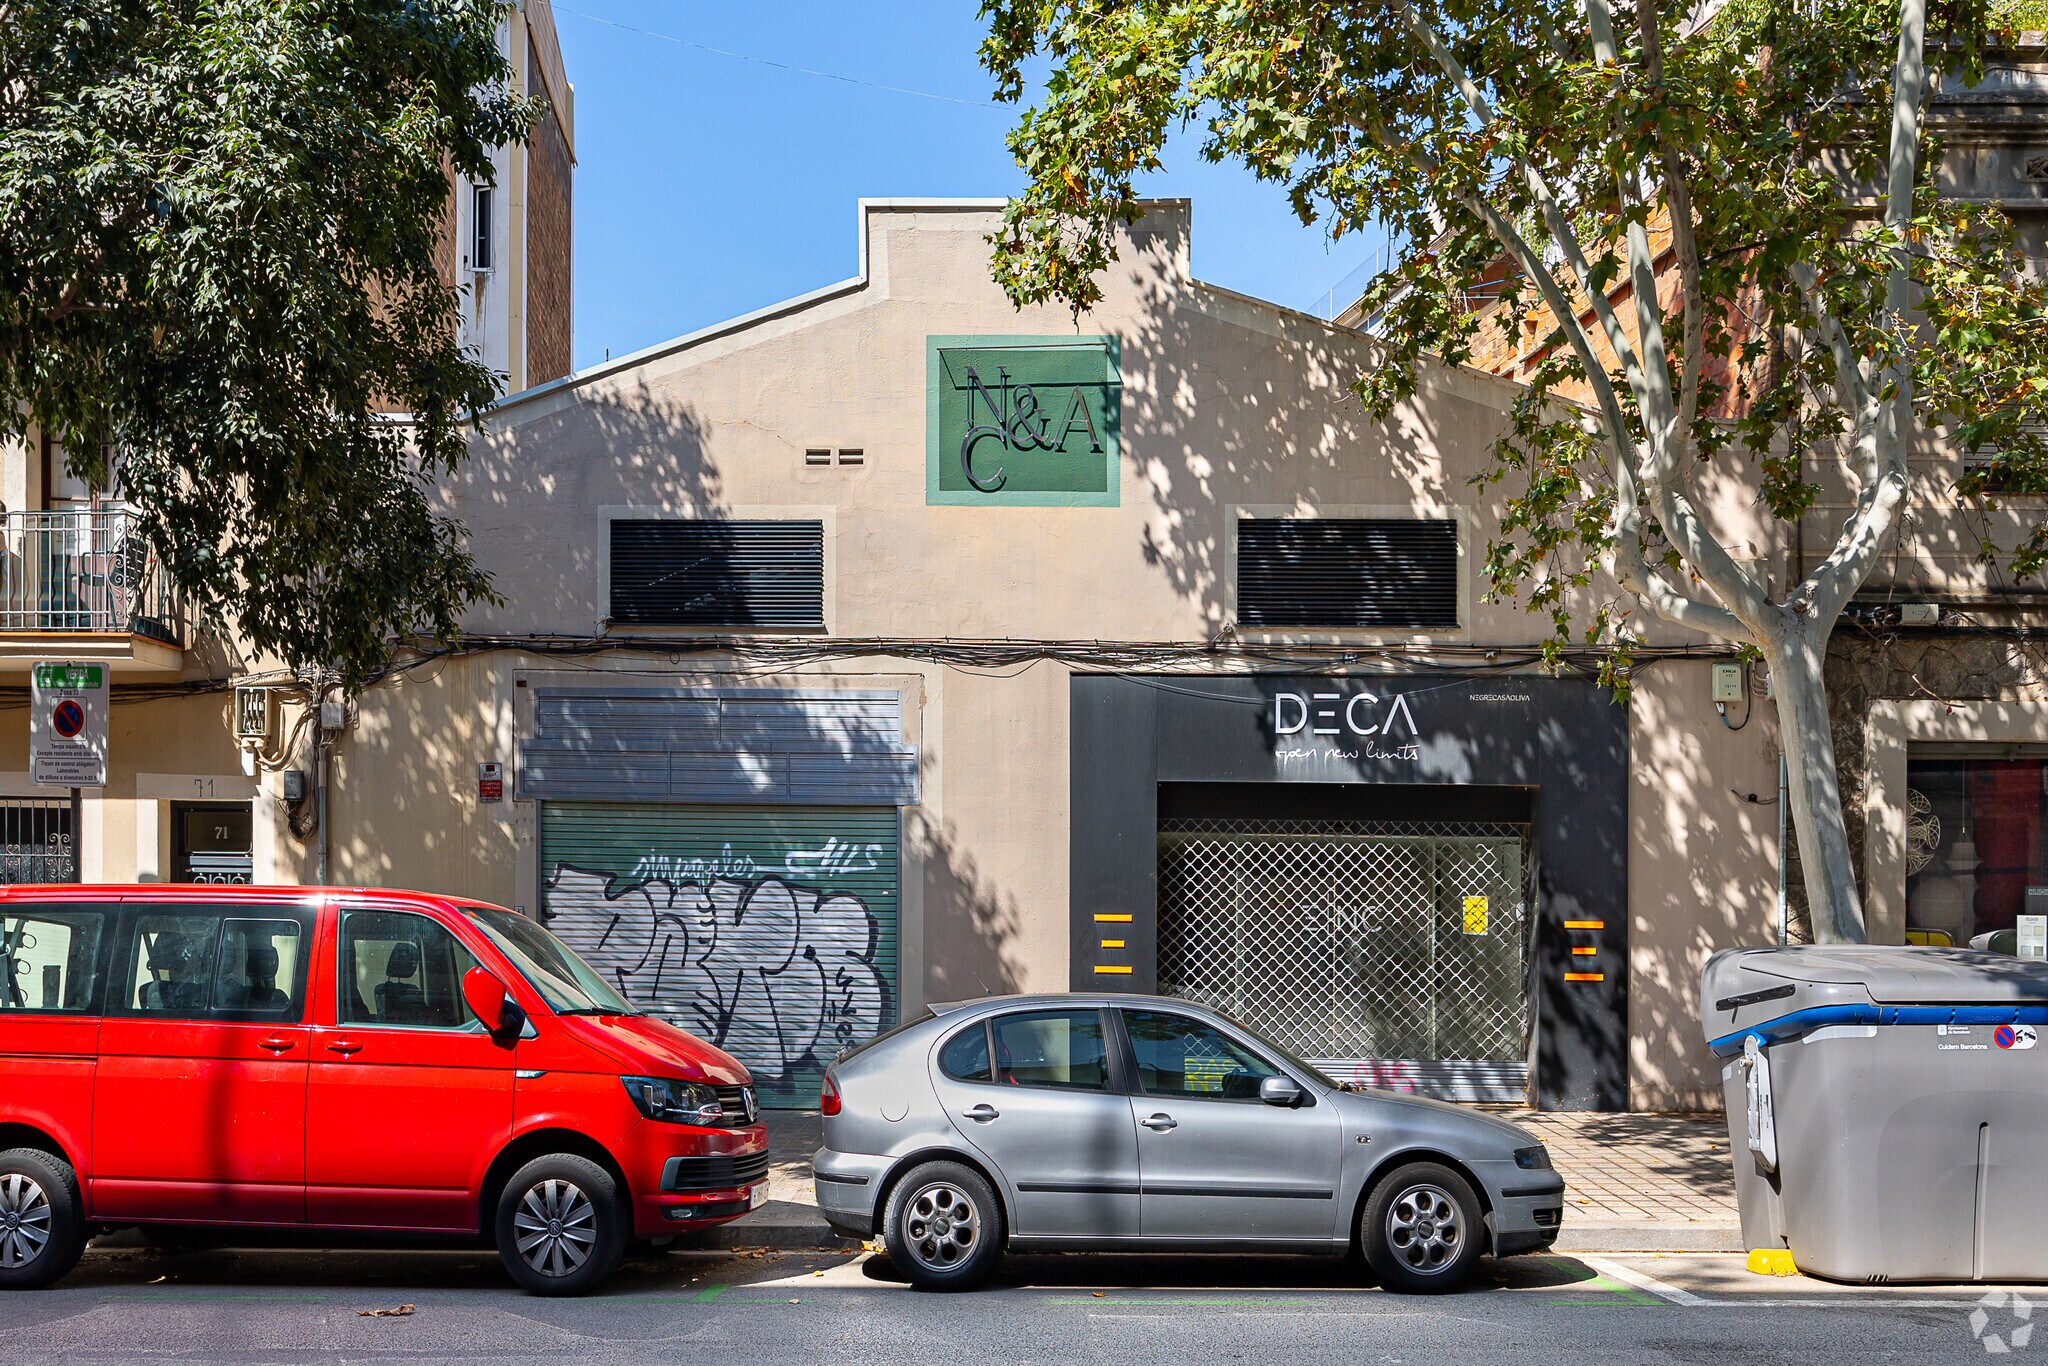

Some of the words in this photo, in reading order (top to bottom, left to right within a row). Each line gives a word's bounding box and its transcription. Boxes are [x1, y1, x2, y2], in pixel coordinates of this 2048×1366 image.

[65, 669, 89, 680] VERDA
[1275, 692, 1419, 735] DECA
[1275, 747, 1317, 766] open
[1324, 747, 1359, 766] new
[1366, 740, 1420, 760] limits
[41, 760, 54, 768] Tiquet
[194, 778, 214, 798] 71
[214, 825, 228, 840] 71
